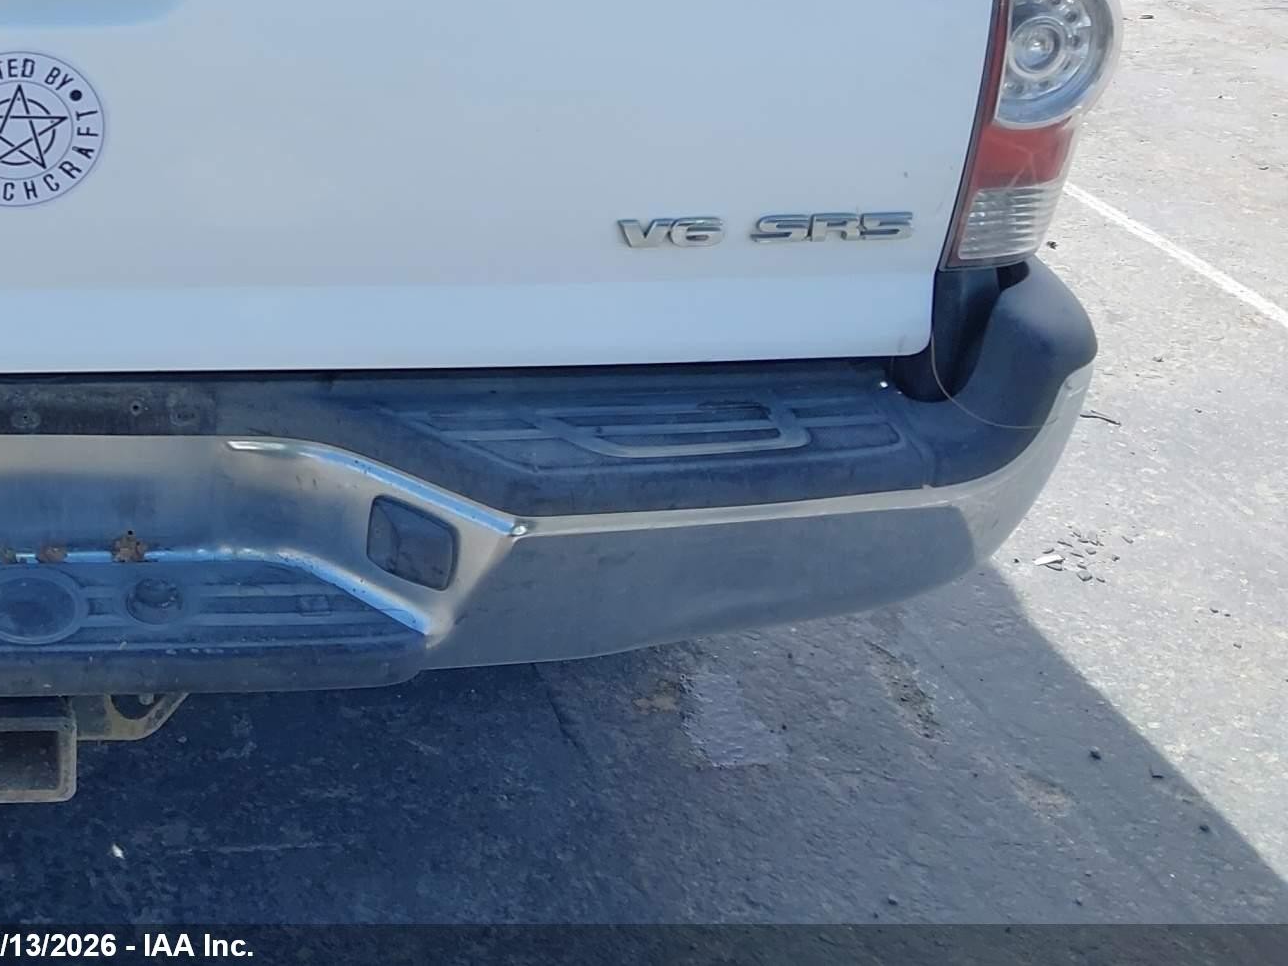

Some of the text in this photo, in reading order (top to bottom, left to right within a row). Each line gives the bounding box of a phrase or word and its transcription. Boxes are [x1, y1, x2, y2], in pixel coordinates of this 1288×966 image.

[44, 67, 74, 91] BY
[617, 211, 914, 248] V6 SR5
